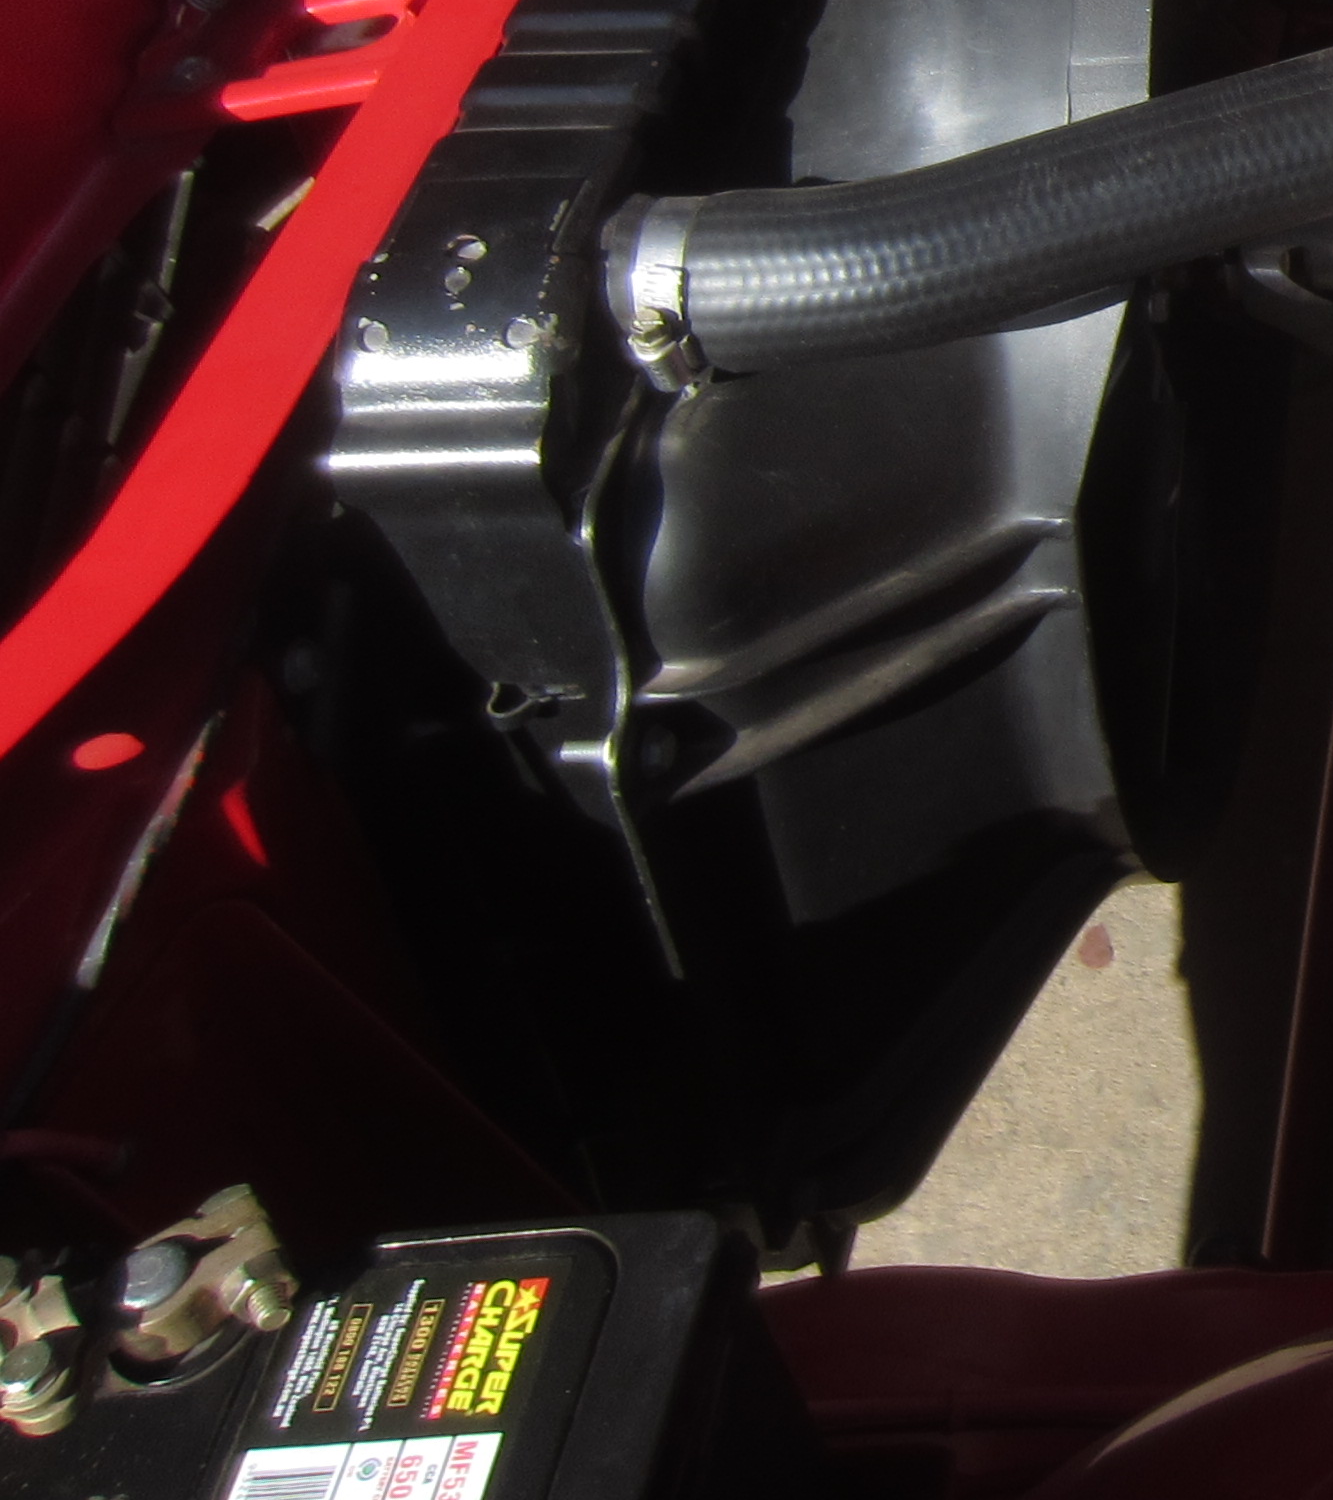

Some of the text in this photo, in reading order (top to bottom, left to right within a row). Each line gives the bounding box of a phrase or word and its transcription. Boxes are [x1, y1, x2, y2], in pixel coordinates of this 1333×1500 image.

[408, 1304, 439, 1350] 1300
[427, 1282, 486, 1417] BATTERIES
[445, 1279, 518, 1413] CHARGE
[475, 1305, 541, 1416] SUPER
[387, 1455, 424, 1499] 650
[422, 1464, 438, 1484] CCA
